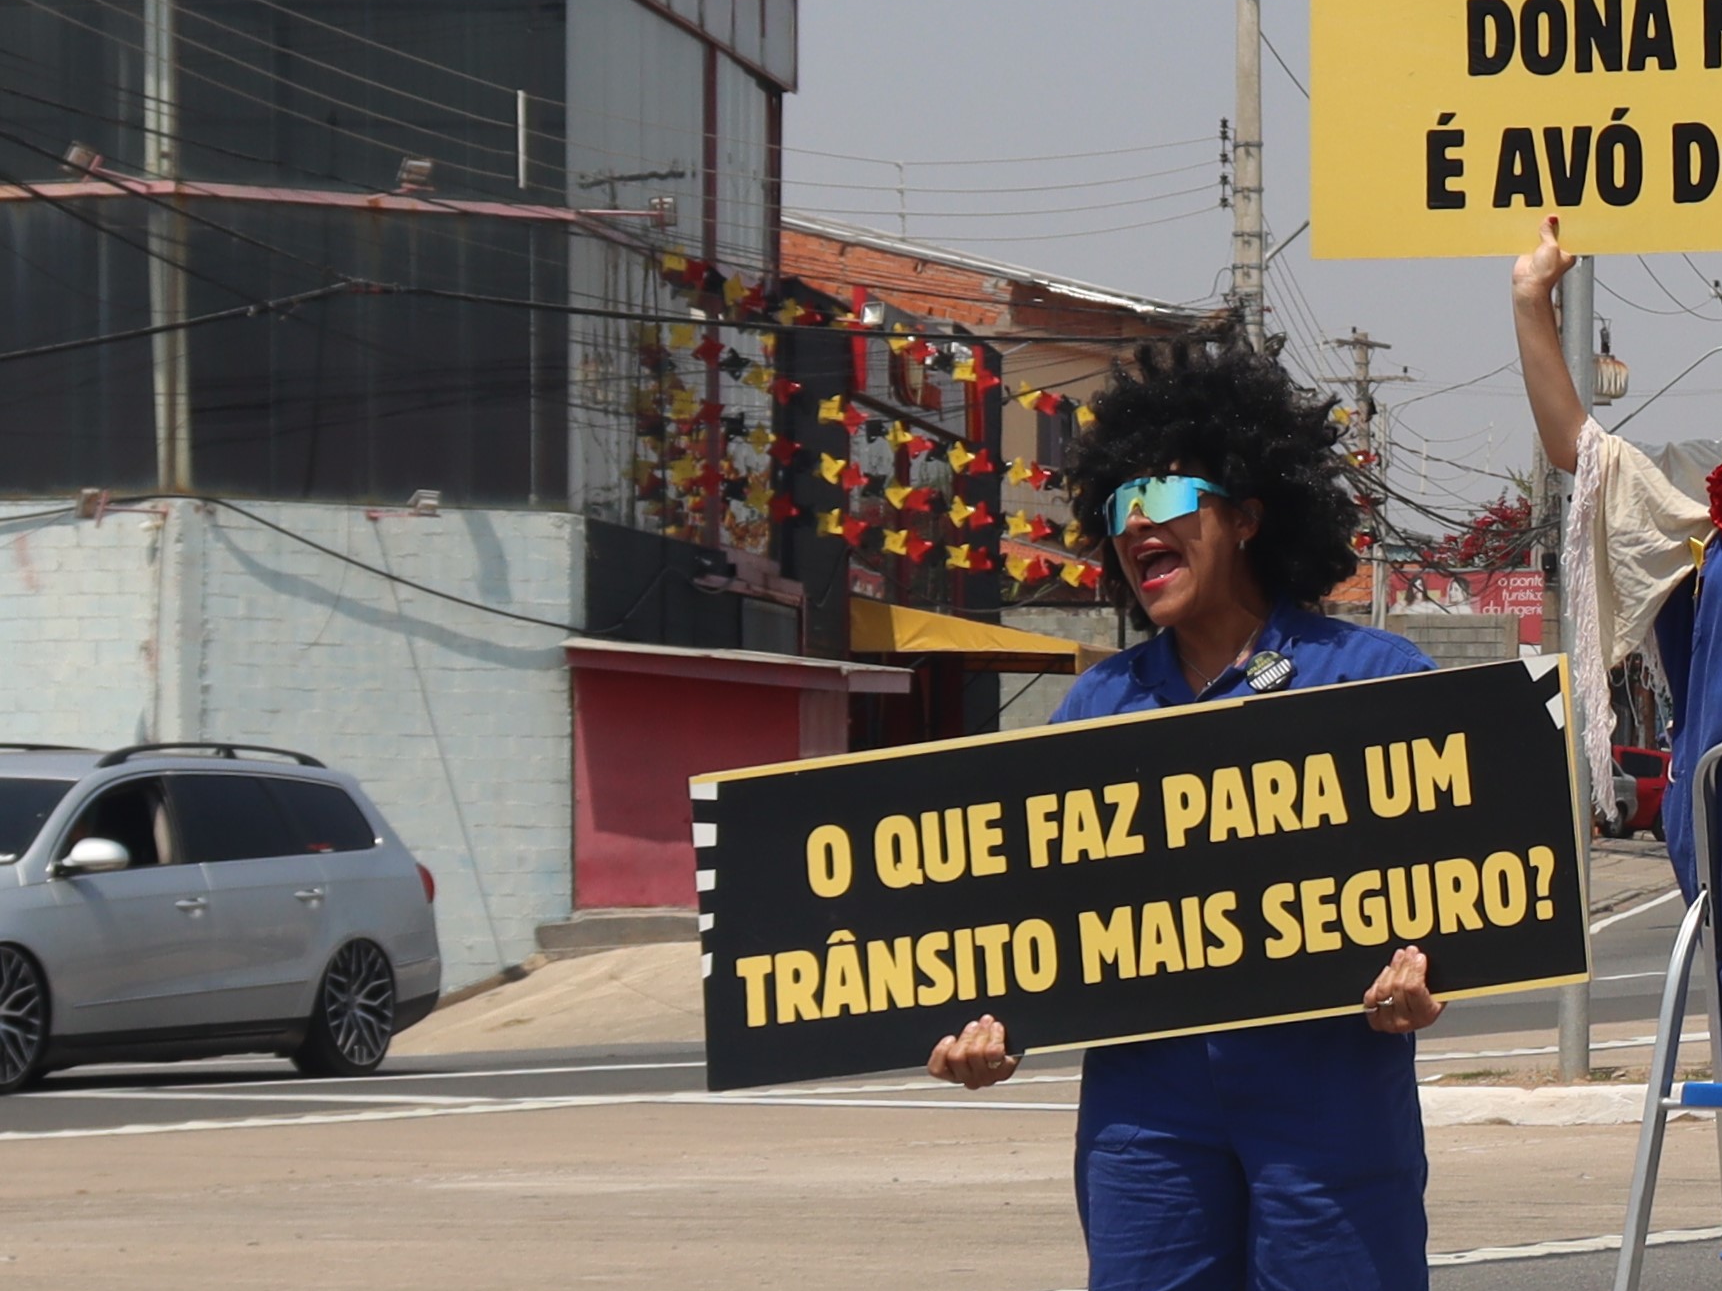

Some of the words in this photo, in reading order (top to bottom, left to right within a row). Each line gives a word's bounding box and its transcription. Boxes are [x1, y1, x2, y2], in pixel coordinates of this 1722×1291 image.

[1426, 112, 1466, 210] É
[1493, 108, 1643, 209] AVÓ
[806, 824, 853, 898] O
[874, 802, 1007, 889] QUE
[1025, 781, 1145, 869] FAZ
[1161, 753, 1349, 849] PARA
[1364, 732, 1472, 818] UM
[736, 918, 1058, 1028] TRÂNSITO
[1079, 890, 1244, 984] MAIS
[1261, 845, 1555, 959] SEGURO?
